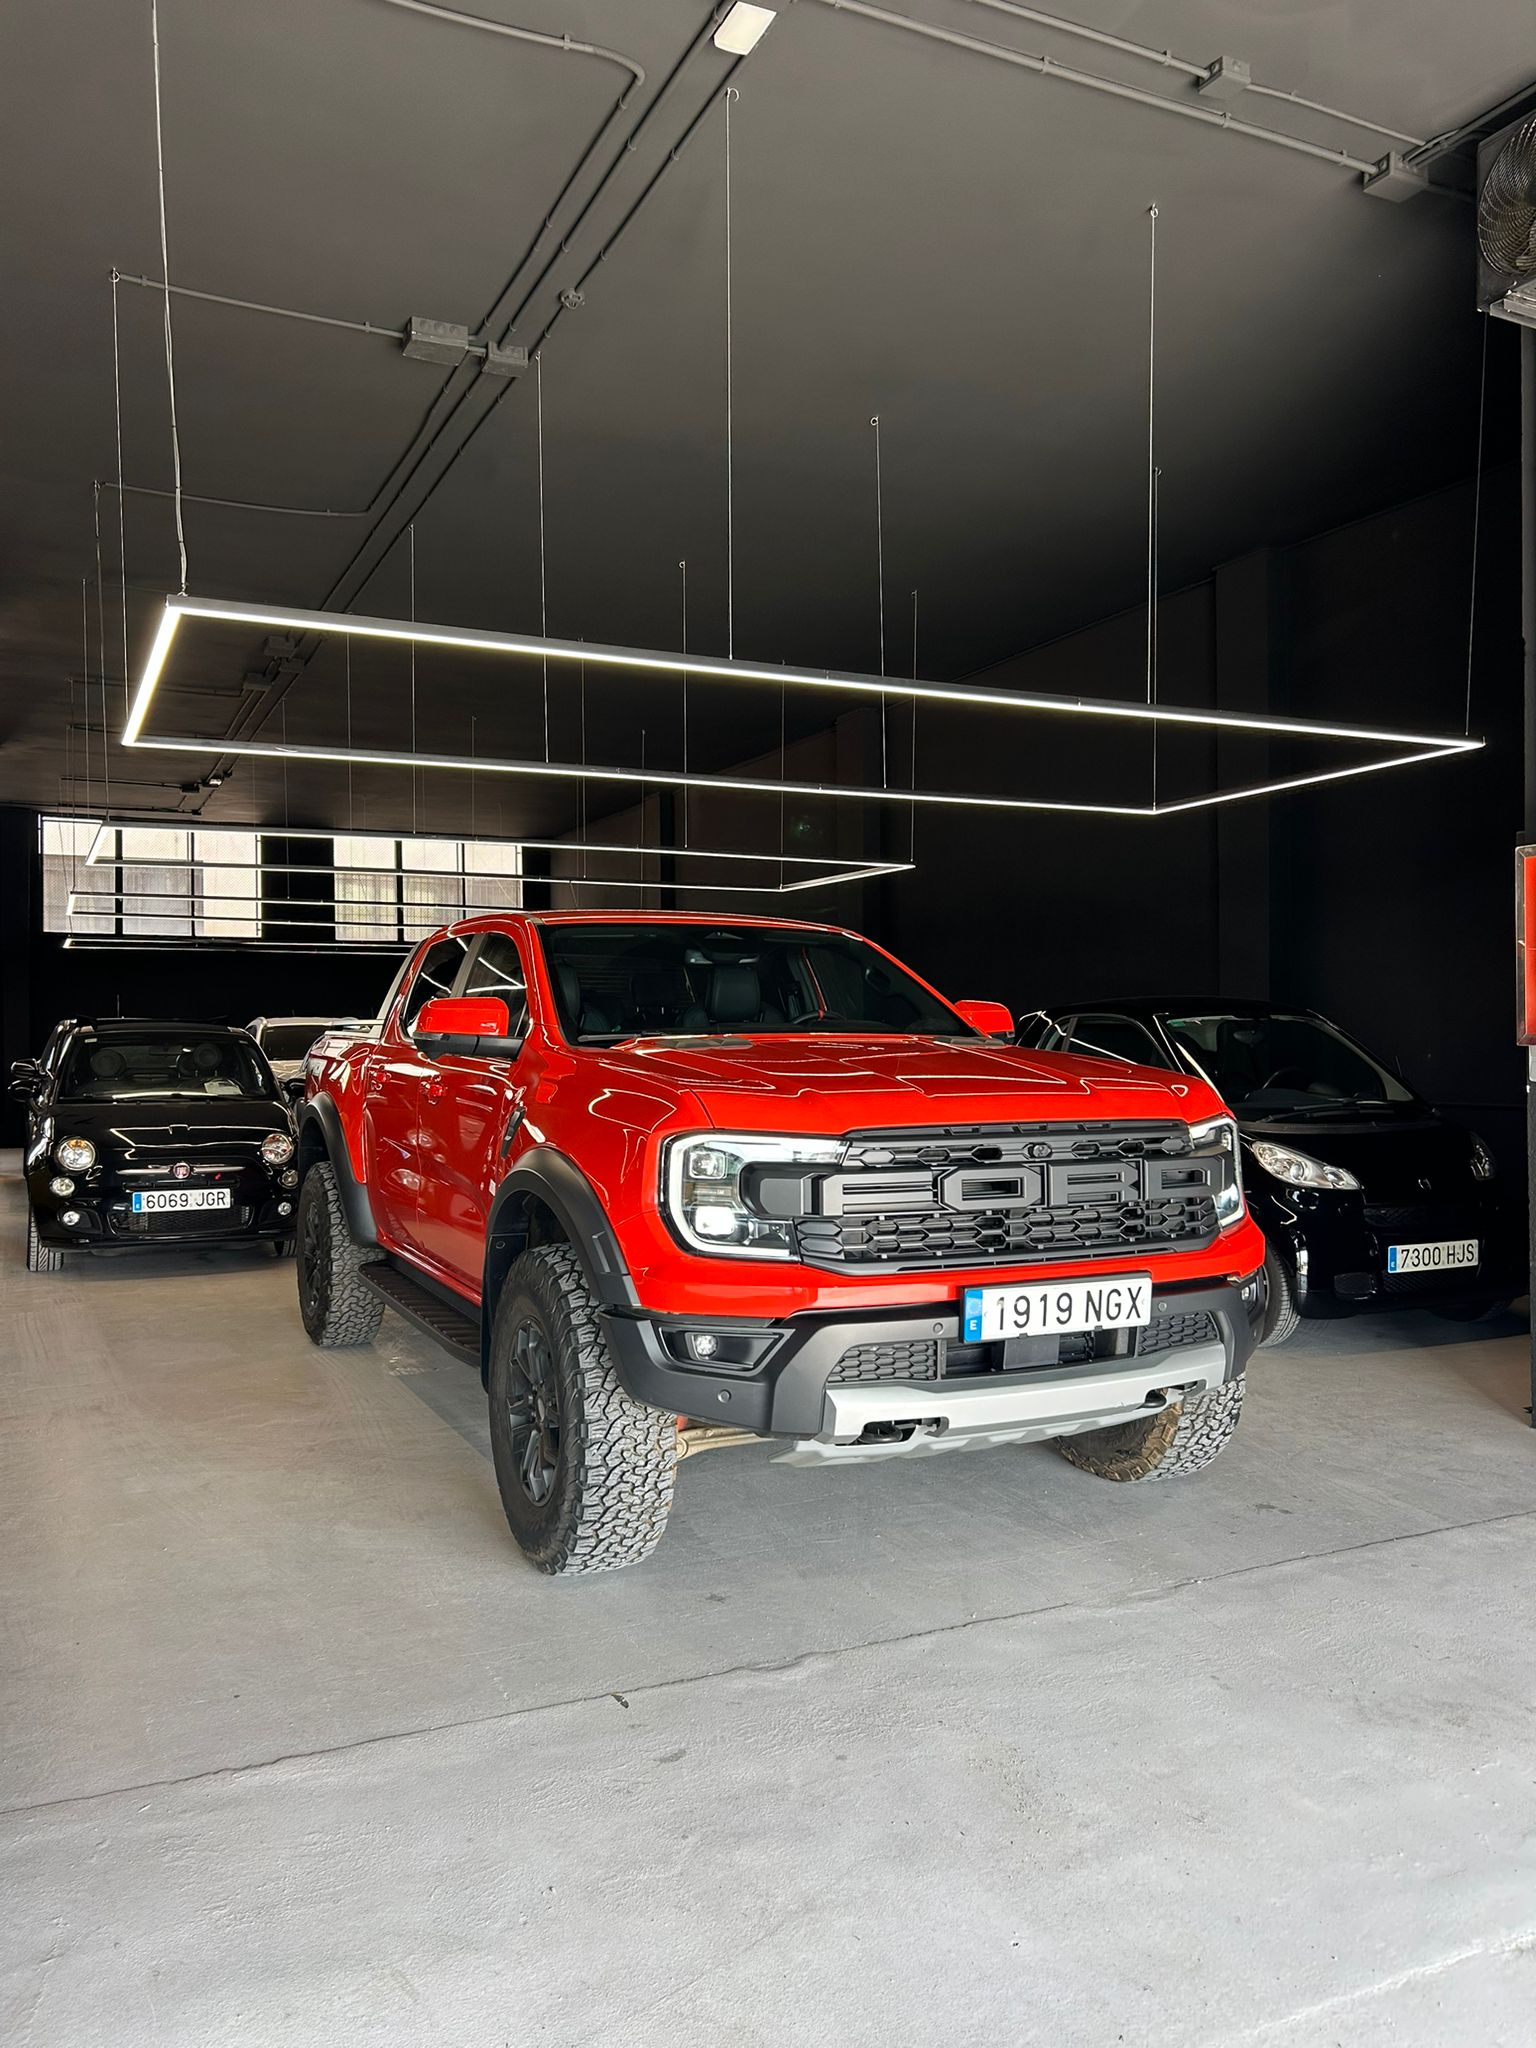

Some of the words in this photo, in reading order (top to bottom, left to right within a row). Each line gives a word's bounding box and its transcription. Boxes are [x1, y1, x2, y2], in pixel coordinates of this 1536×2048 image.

[821, 1154, 1226, 1217] FORD
[146, 1193, 189, 1209] 6069
[196, 1191, 226, 1207] JGR
[1401, 1246, 1441, 1269] 7300
[1447, 1243, 1475, 1265] HJS
[996, 1291, 1073, 1331] 1919
[1085, 1285, 1143, 1324] NGX
[969, 1319, 978, 1331] E
